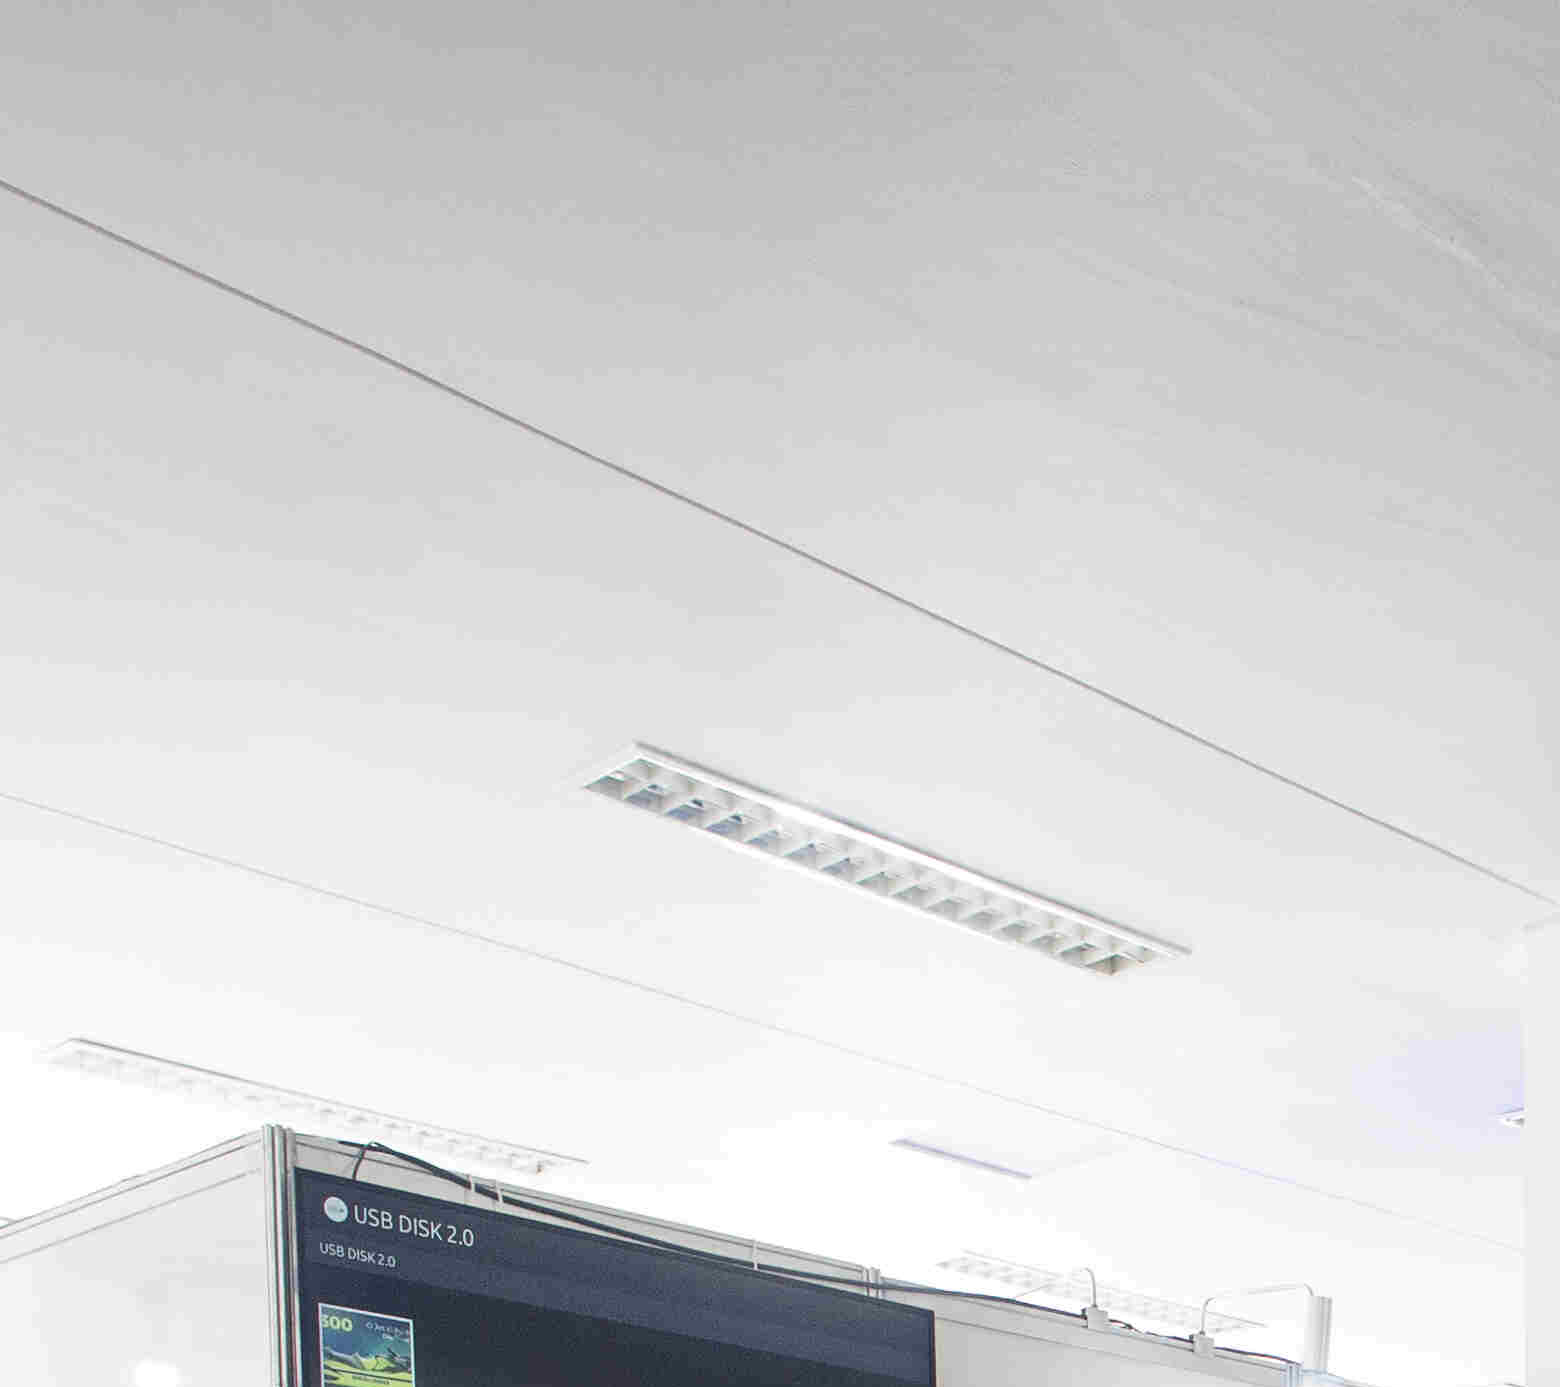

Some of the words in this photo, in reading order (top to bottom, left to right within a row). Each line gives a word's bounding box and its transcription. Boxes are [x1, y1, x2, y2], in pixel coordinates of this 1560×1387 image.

[354, 1205, 393, 1229] USB
[399, 1215, 442, 1241] DISK
[447, 1227, 474, 1247] 2.0
[319, 1242, 344, 1258] USB
[348, 1248, 376, 1264] DISK
[378, 1253, 397, 1268] 2.0
